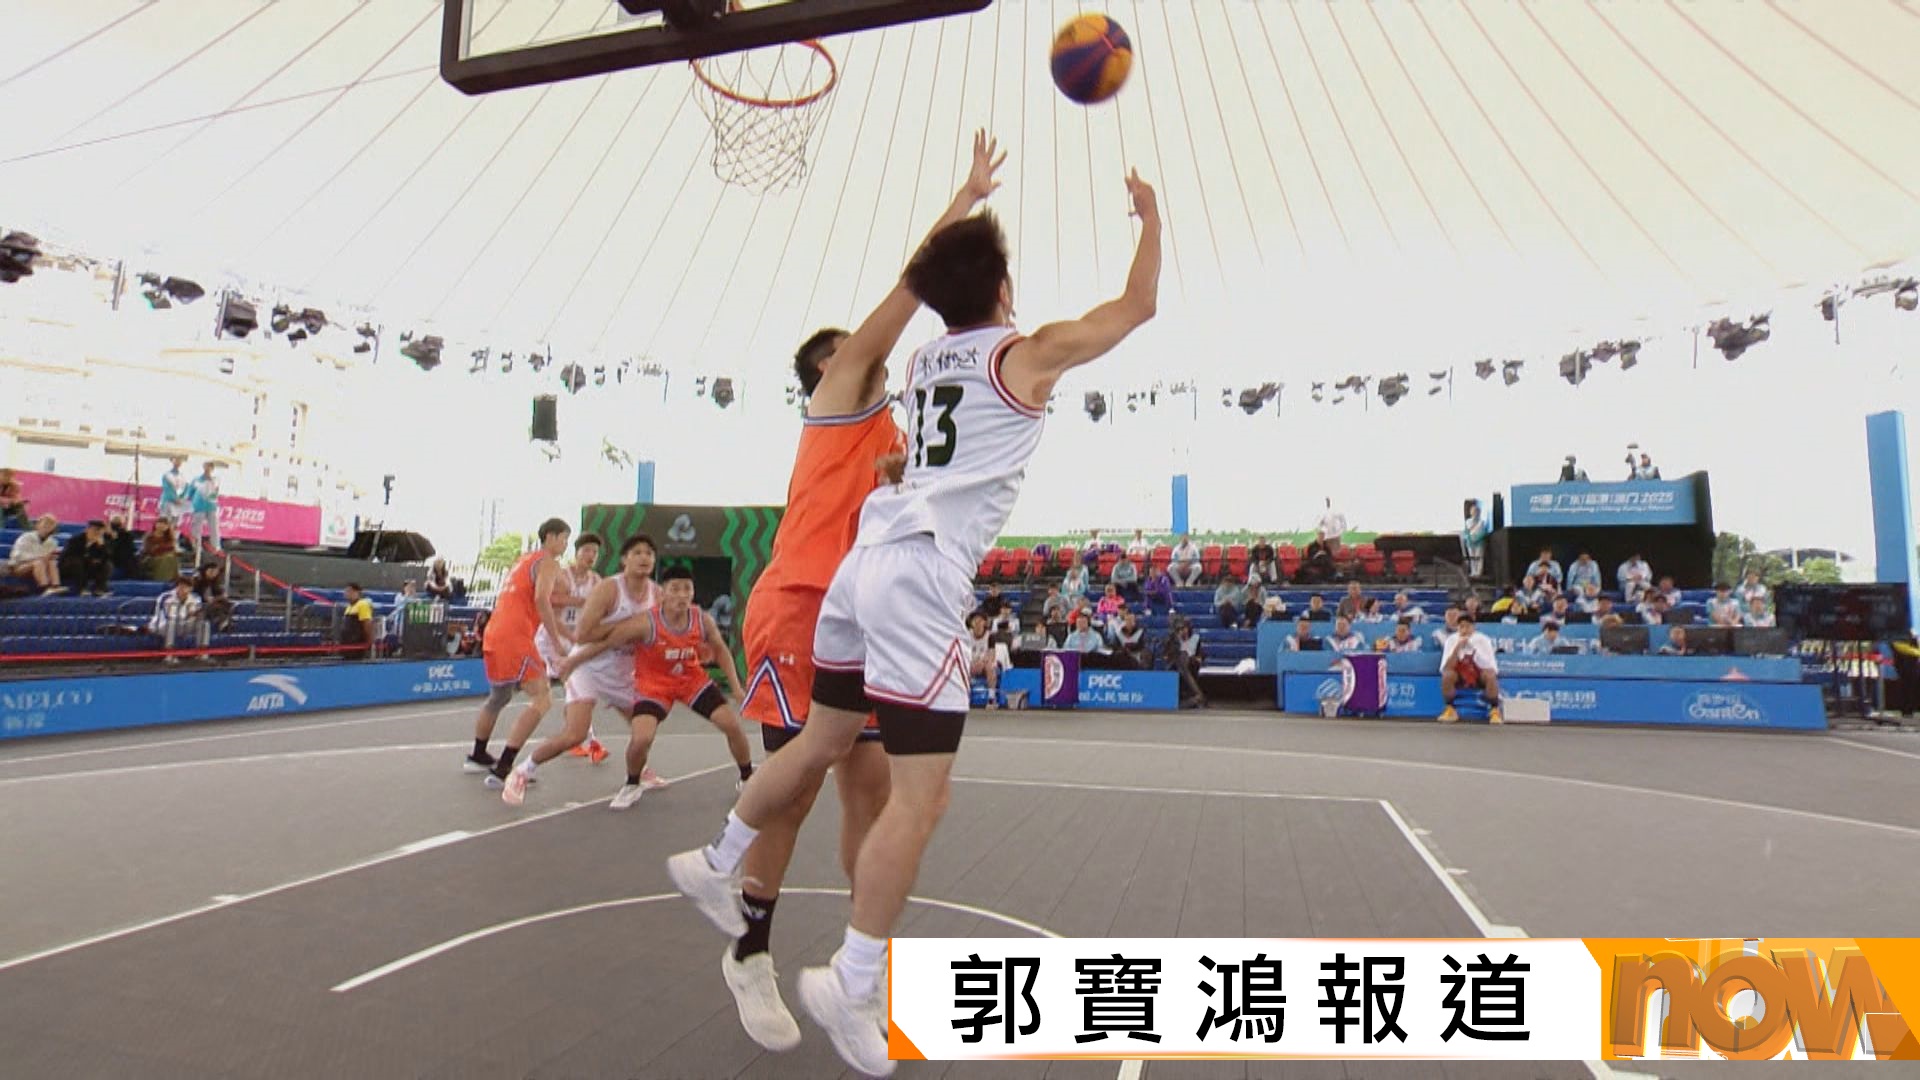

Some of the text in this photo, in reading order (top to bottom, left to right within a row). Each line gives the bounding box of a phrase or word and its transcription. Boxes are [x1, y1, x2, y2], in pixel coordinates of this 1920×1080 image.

[915, 385, 964, 468] 13
[1088, 674, 1122, 689] PICC
[247, 693, 285, 711] ANTA
